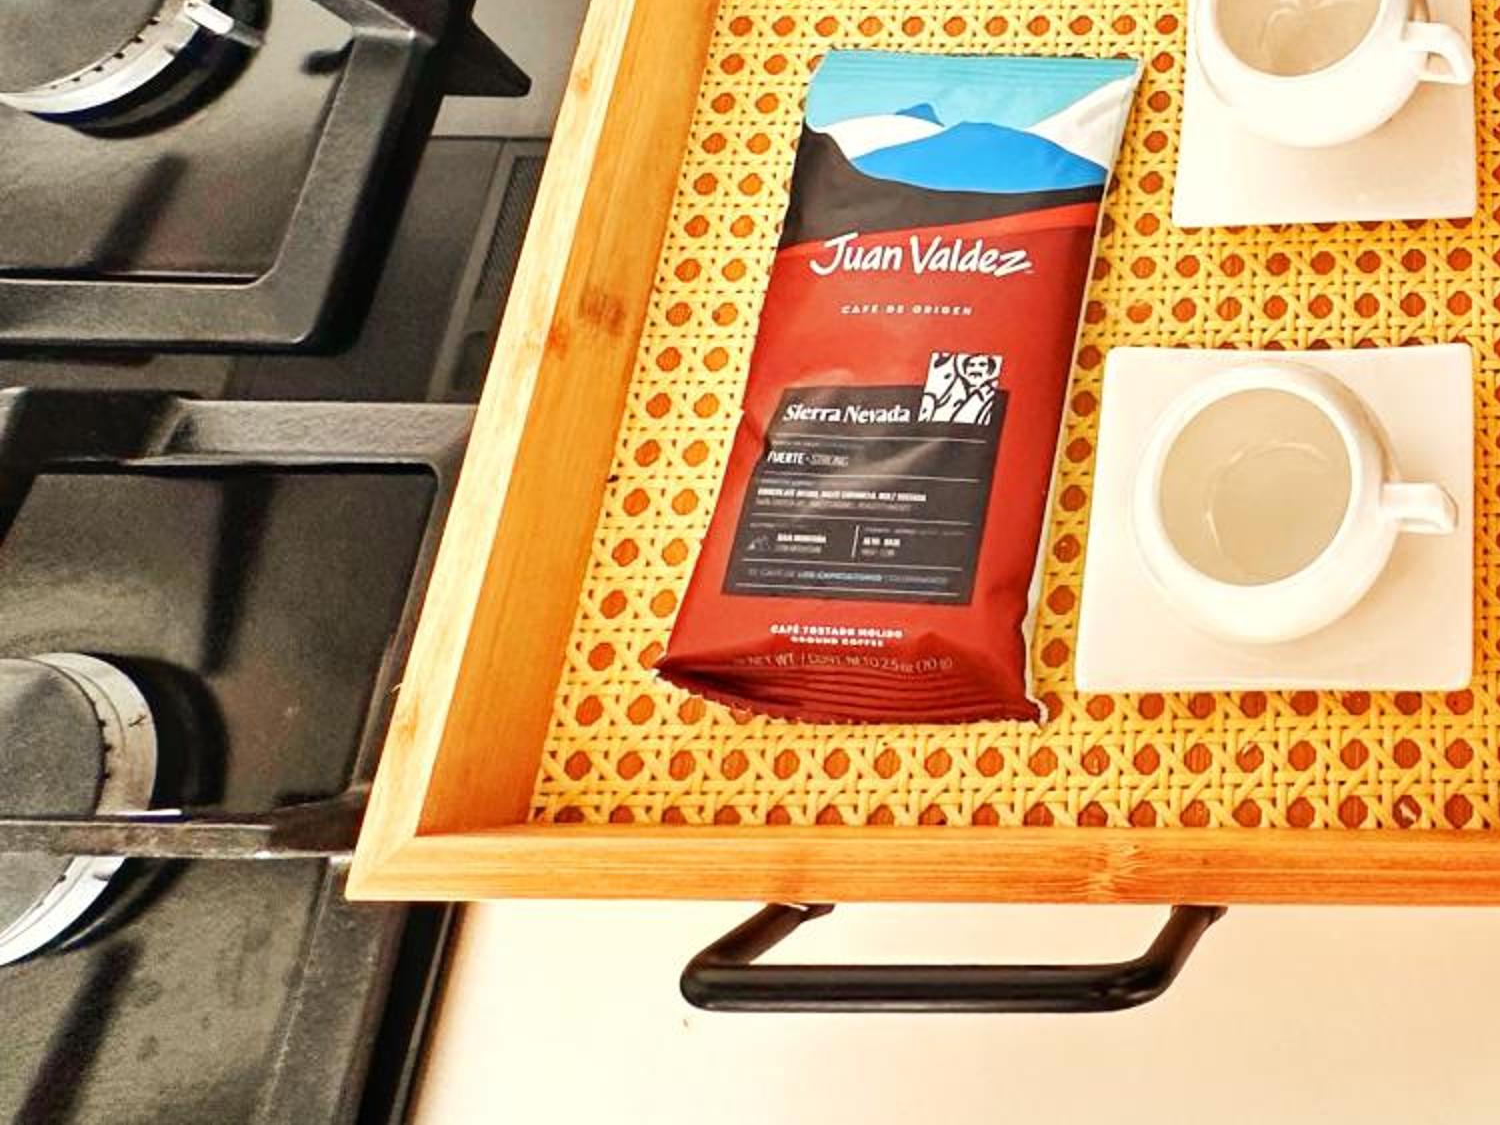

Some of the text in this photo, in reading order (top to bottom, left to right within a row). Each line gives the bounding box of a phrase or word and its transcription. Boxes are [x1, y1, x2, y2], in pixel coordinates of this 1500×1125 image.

[810, 232, 1032, 277] Juan Valdez
[886, 305, 904, 314] DE
[911, 305, 972, 316] ORIGEN
[782, 404, 910, 423] Sierra Nevada
[858, 627, 902, 638] MOLIDO
[790, 636, 883, 647] GROUND COFFEE
